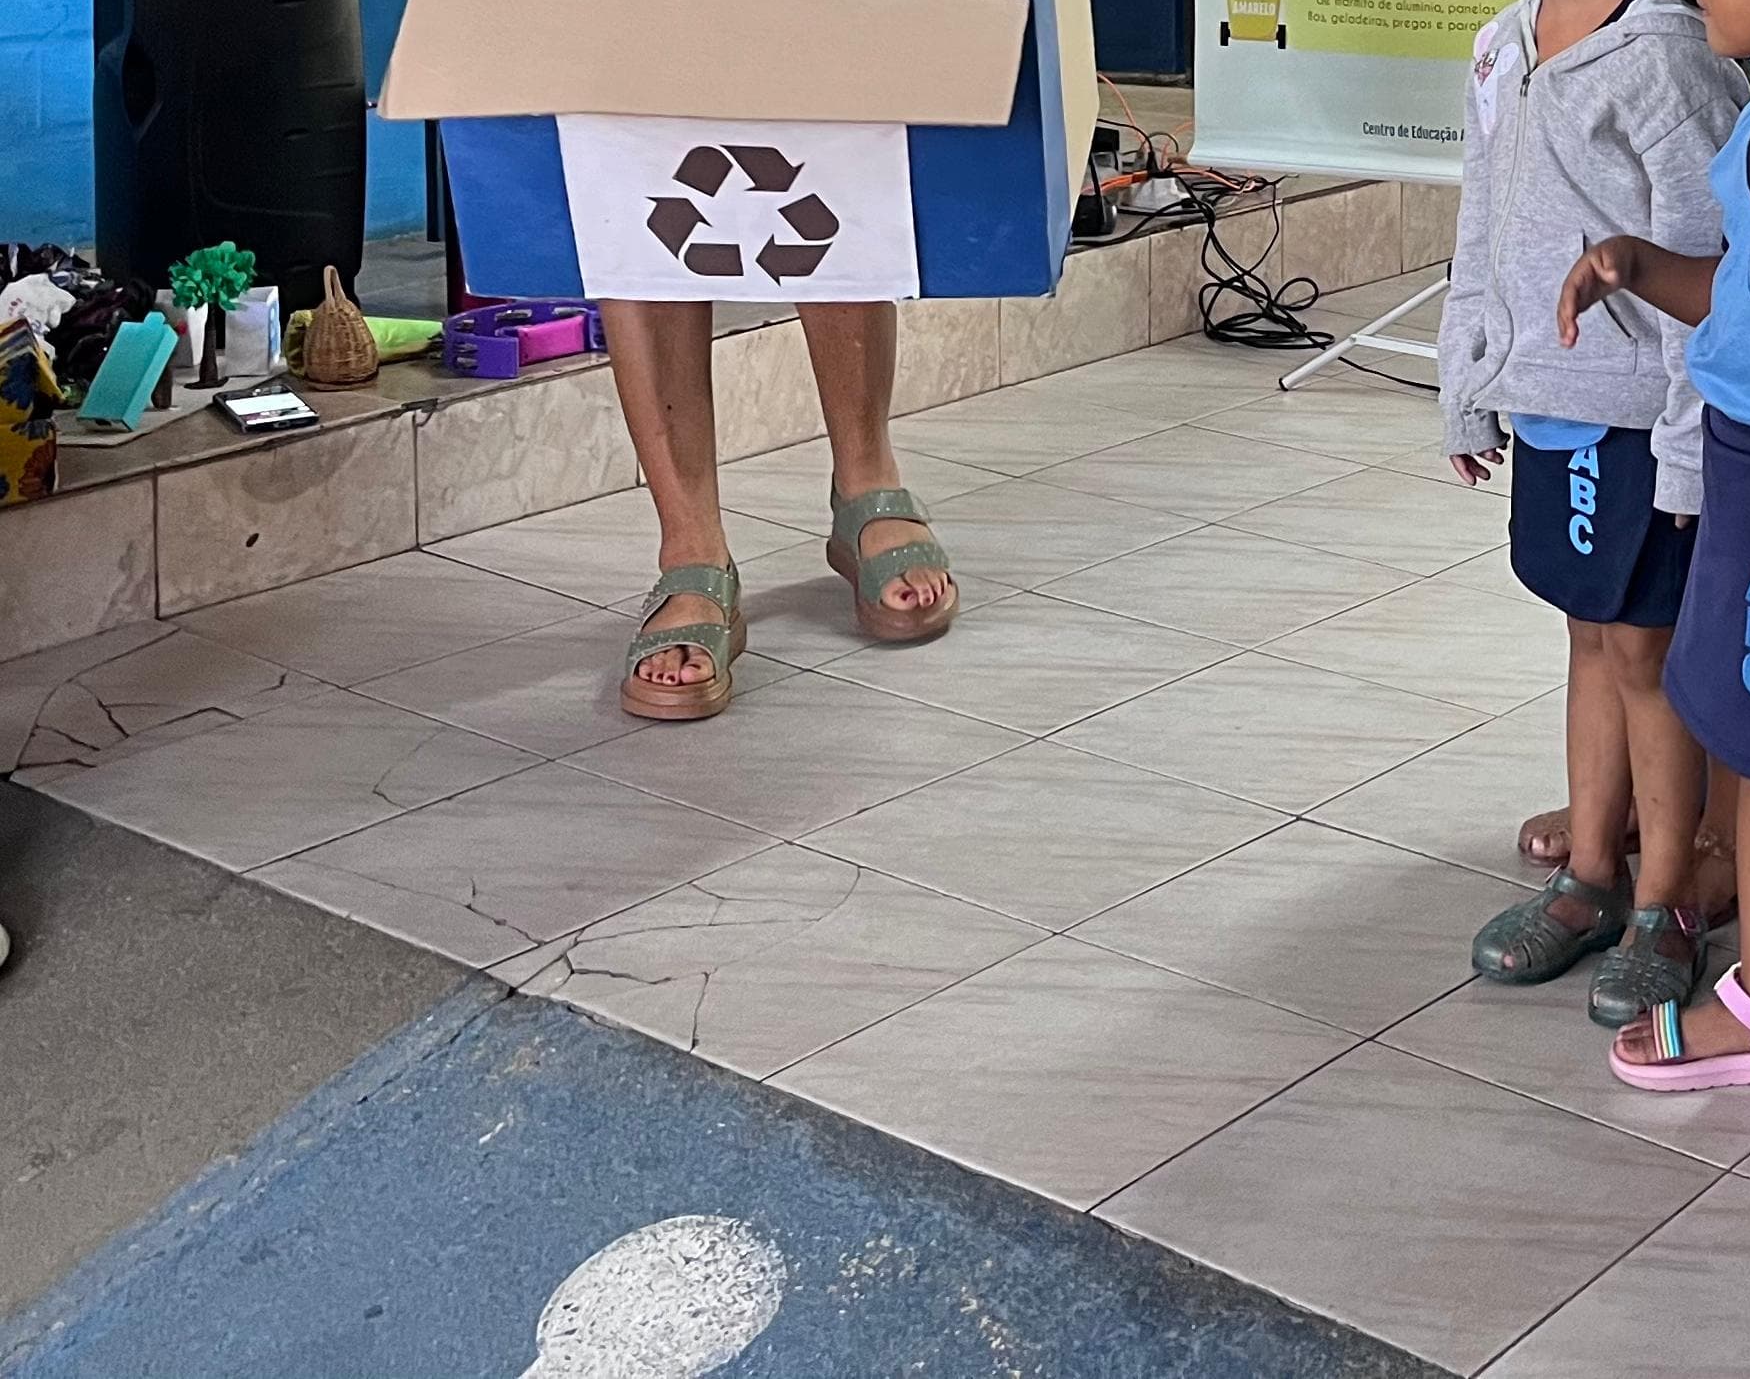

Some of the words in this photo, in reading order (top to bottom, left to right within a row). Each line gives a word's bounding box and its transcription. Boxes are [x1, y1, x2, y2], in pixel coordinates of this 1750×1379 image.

[1232, 1, 1276, 15] AMARELO
[1378, 0, 1392, 11] de
[1392, 19, 1432, 31] pregos
[1436, 21, 1443, 29] e
[1363, 122, 1394, 137] Centro
[1398, 124, 1408, 137] de
[1412, 126, 1457, 143] Educação
[1568, 445, 1600, 555] ABC
